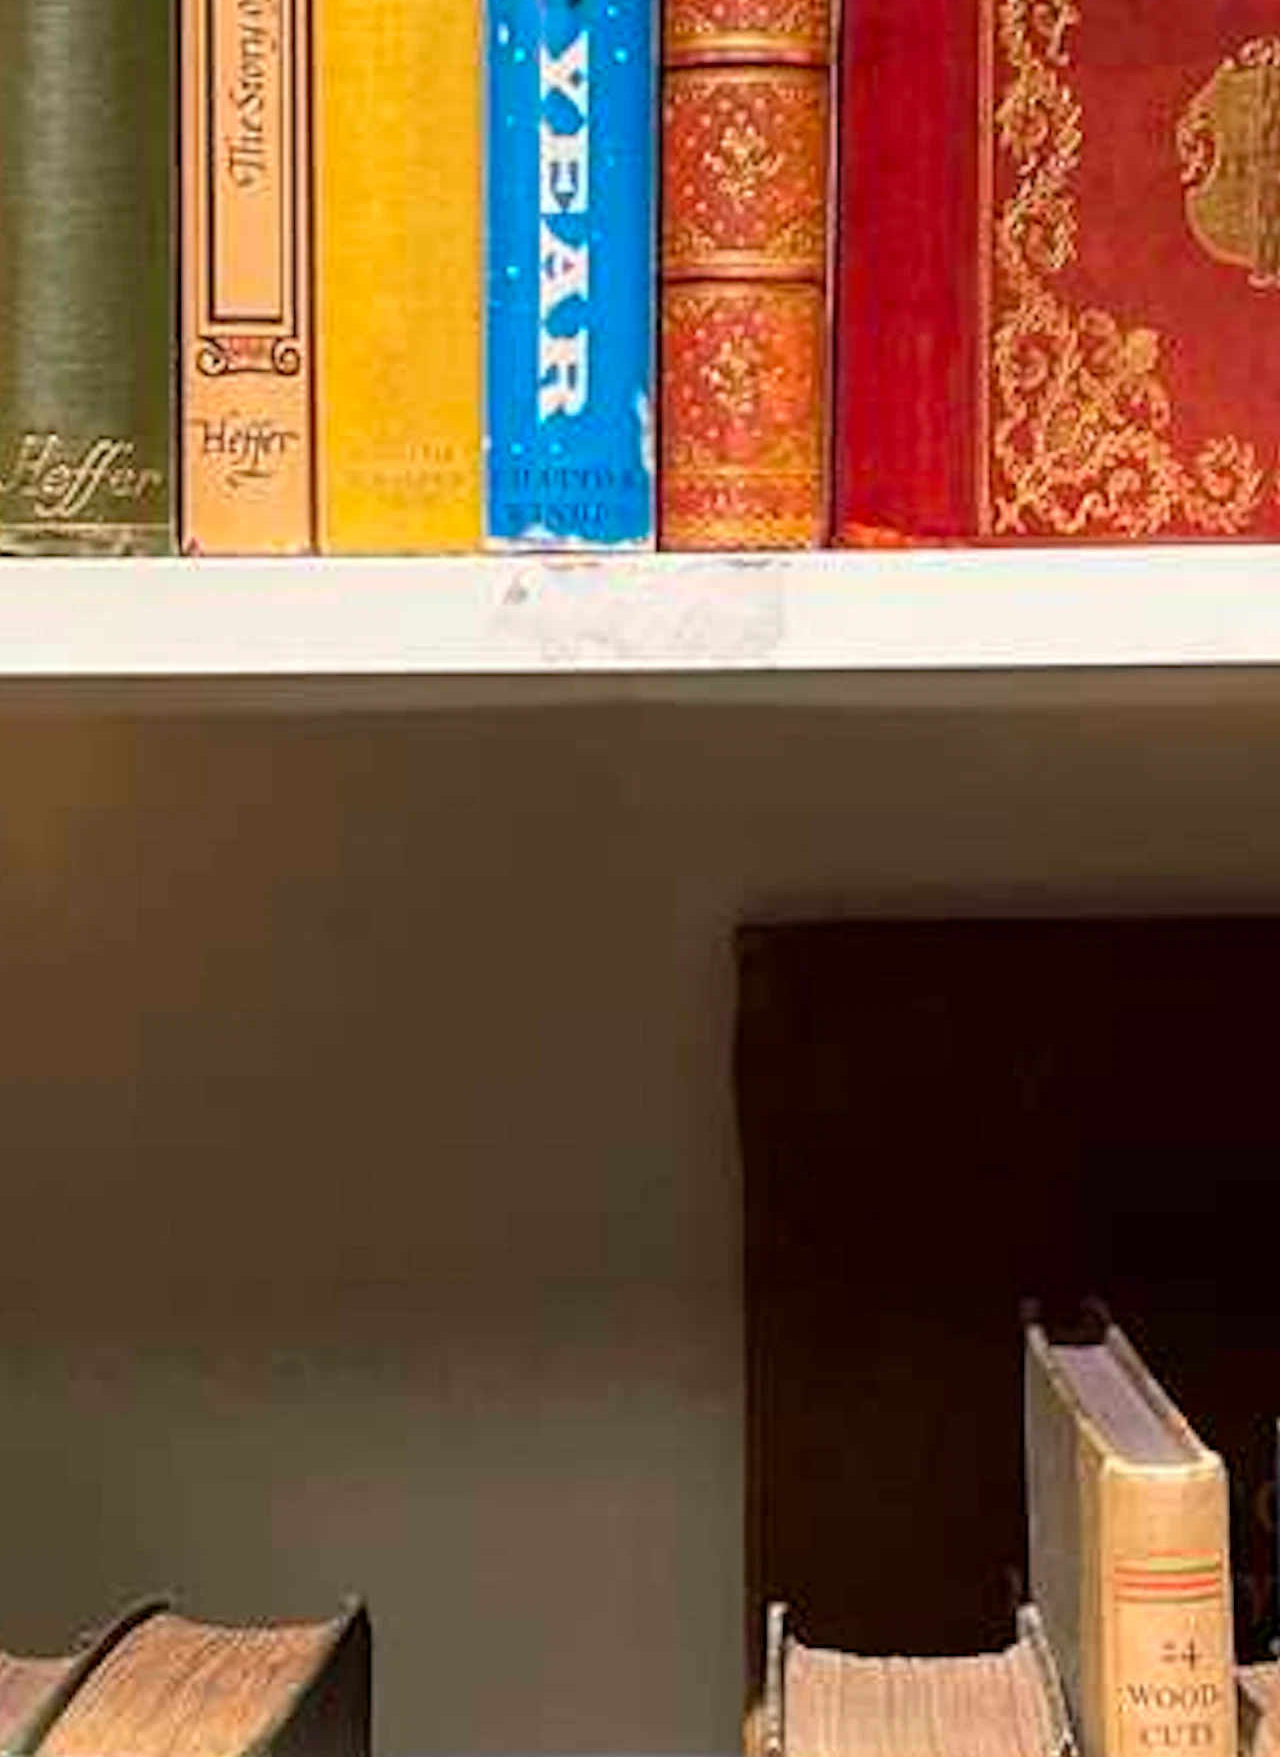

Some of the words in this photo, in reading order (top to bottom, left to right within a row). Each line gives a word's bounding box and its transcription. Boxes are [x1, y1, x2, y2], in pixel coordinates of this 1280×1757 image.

[228, 26, 275, 111] Story
[225, 120, 266, 190] The
[538, 31, 588, 422] YEAR
